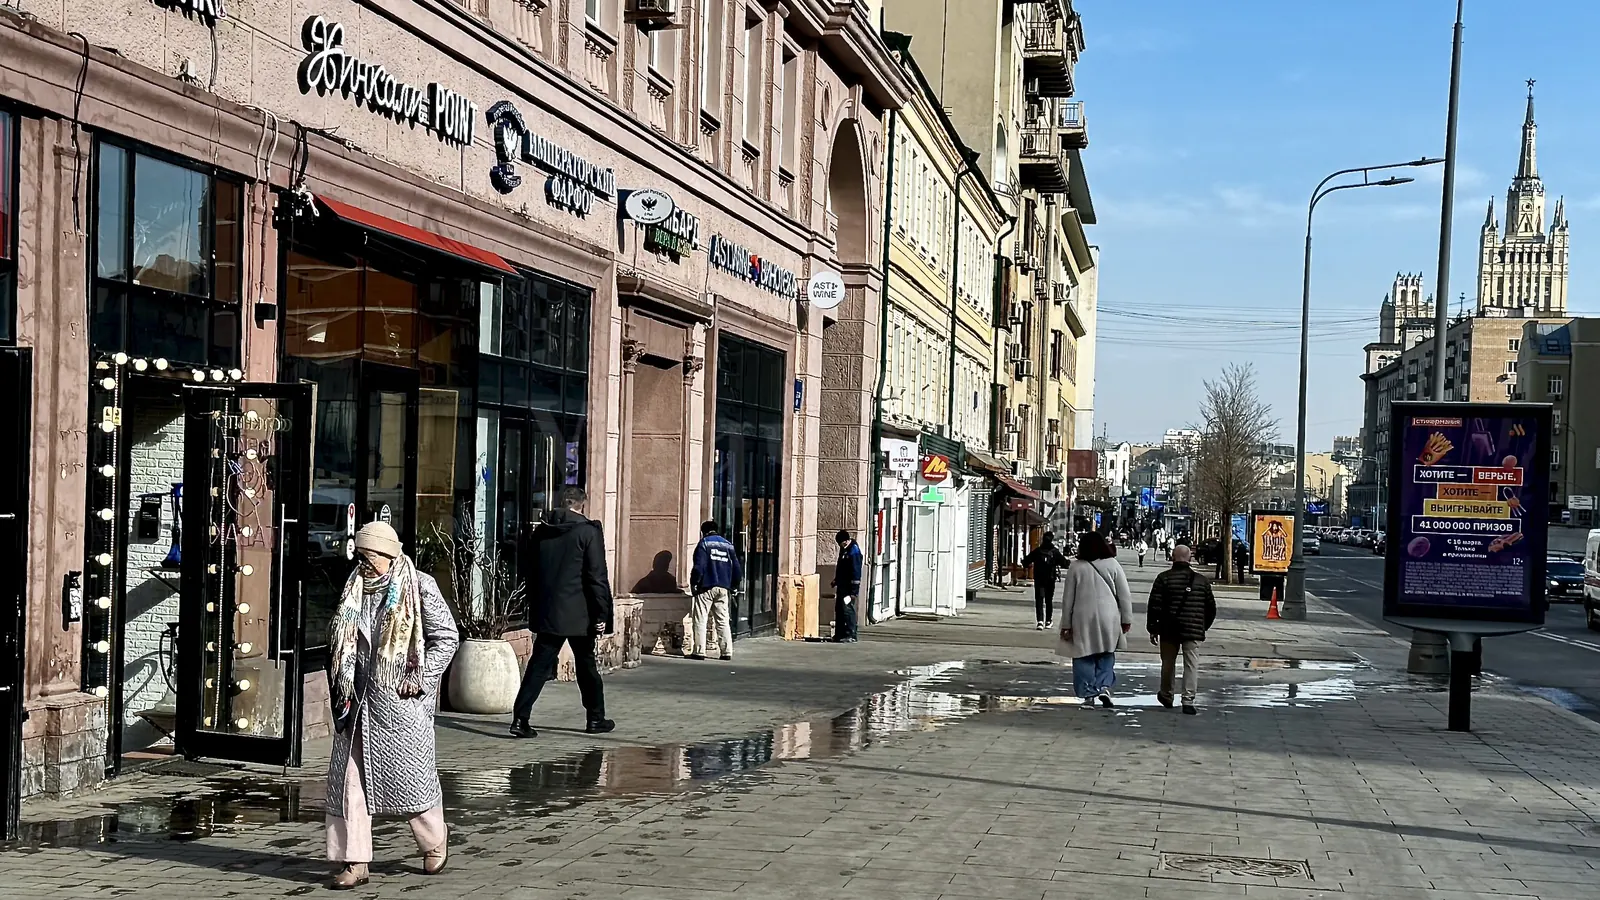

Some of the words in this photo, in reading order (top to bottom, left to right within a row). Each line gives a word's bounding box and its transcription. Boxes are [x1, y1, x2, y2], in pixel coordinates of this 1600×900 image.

[434, 82, 478, 146] POINT
[551, 176, 597, 215] ФАРФОР
[1419, 470, 1455, 479] ХОТИТЕ
[1443, 487, 1479, 496] ХОТИТЕ
[1430, 503, 1504, 514] ВЫИГРЫВАЙТЕ
[1473, 522, 1513, 532] ПРИЗОВ
